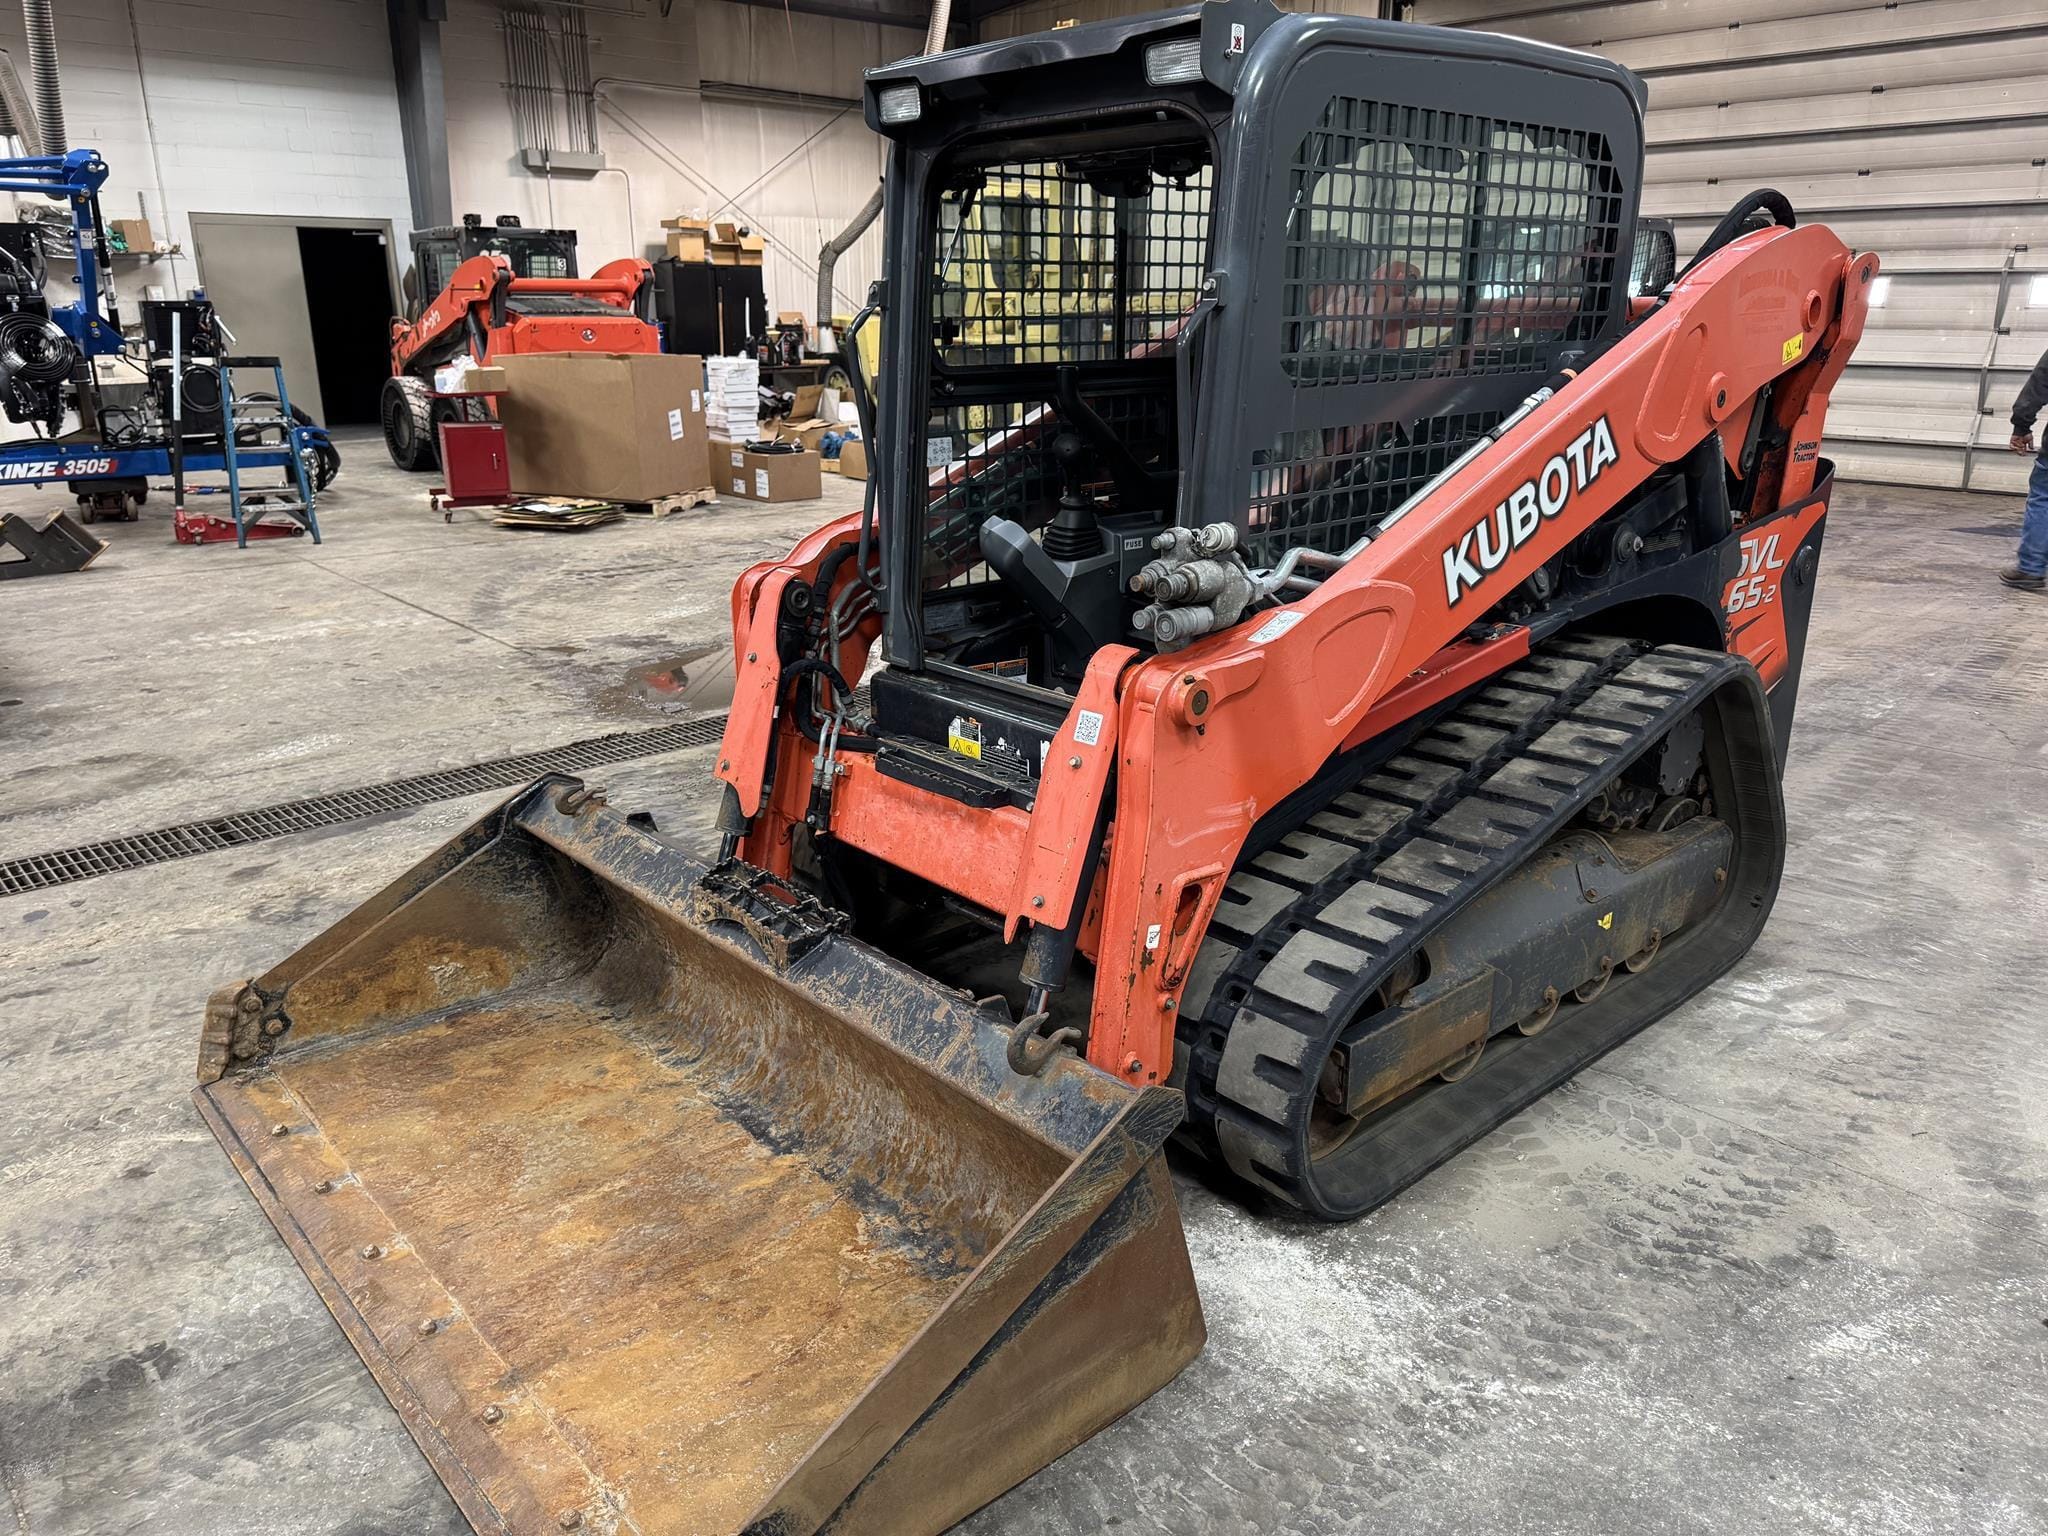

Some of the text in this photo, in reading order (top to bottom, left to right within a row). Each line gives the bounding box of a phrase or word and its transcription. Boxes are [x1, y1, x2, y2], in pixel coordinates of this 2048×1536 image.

[63, 458, 111, 476] 3505
[1442, 415, 1618, 607] KUBOTA
[1727, 575, 1777, 614] 65-2
